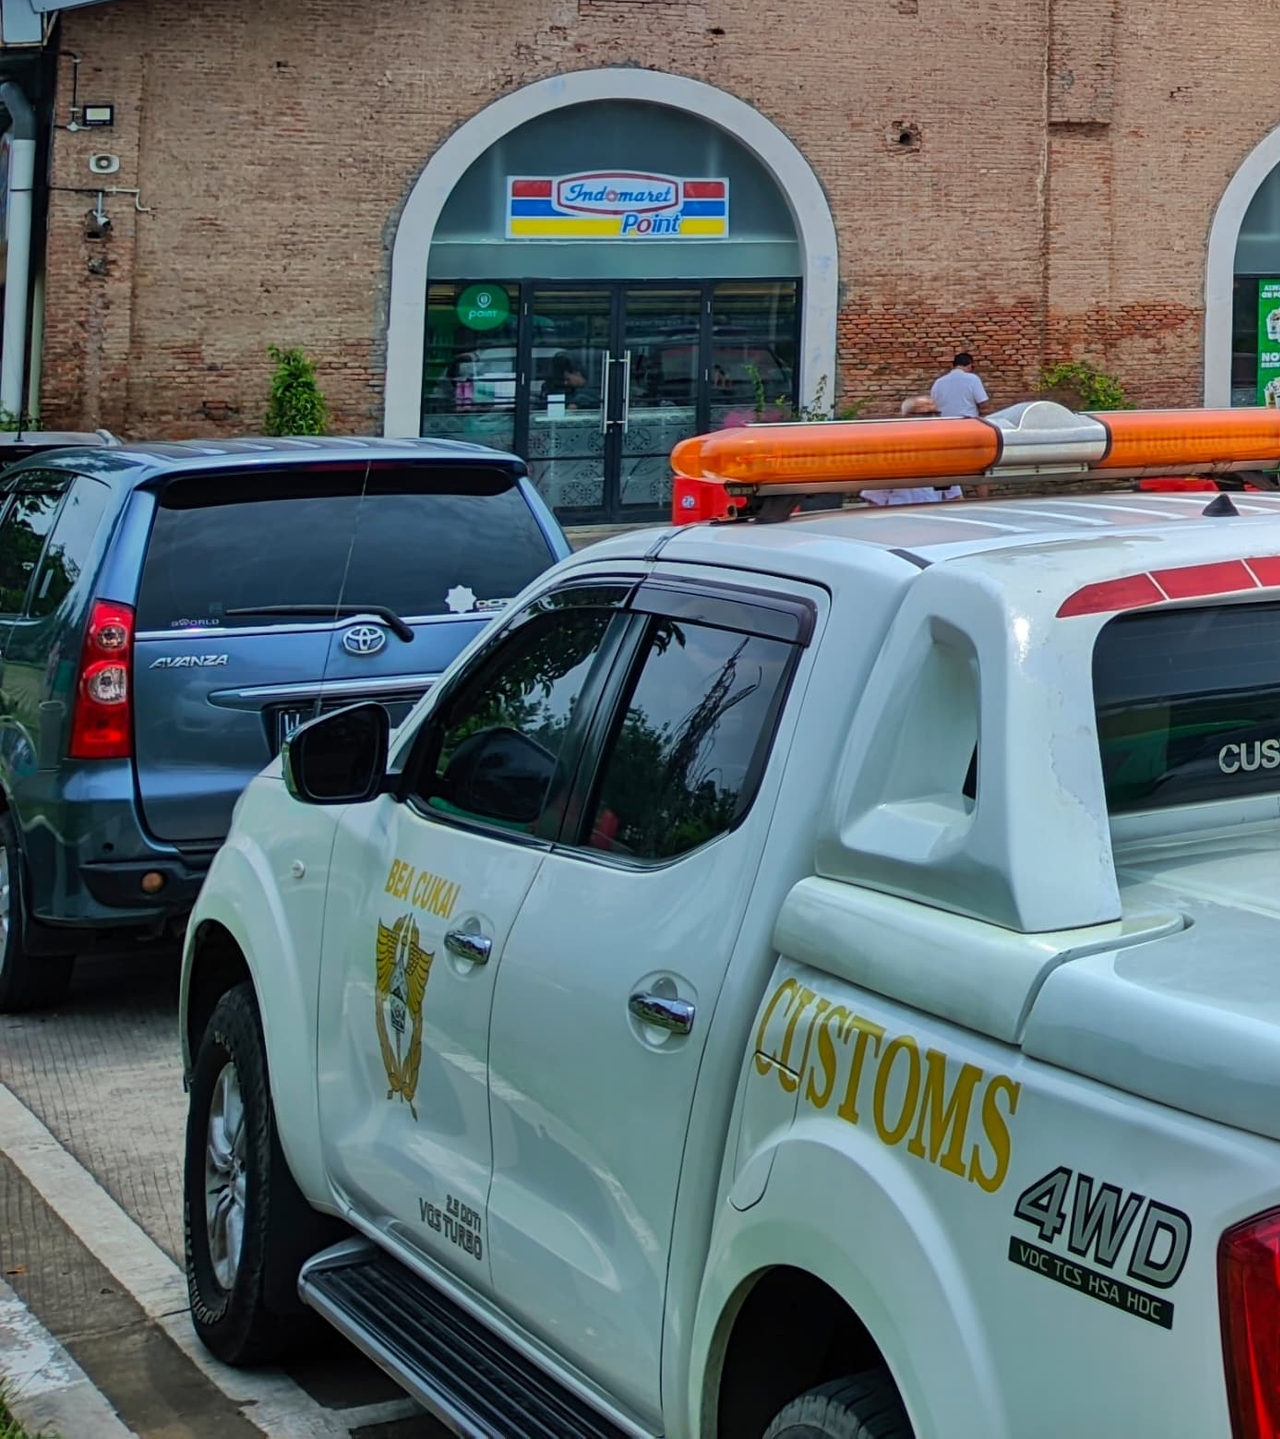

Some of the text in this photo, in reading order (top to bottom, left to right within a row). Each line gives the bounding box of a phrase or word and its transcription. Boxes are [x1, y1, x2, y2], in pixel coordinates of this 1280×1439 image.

[565, 183, 672, 202] Indomaret
[622, 213, 681, 234] Point
[148, 654, 229, 668] AVANZA
[384, 858, 462, 920] BEA CUKAI
[755, 976, 1022, 1194] CUSTOMS
[442, 1212, 483, 1262] TURBO
[1013, 1165, 1192, 1290] 4WD
[1019, 1244, 1162, 1320] VDC TCS HSA HDC
